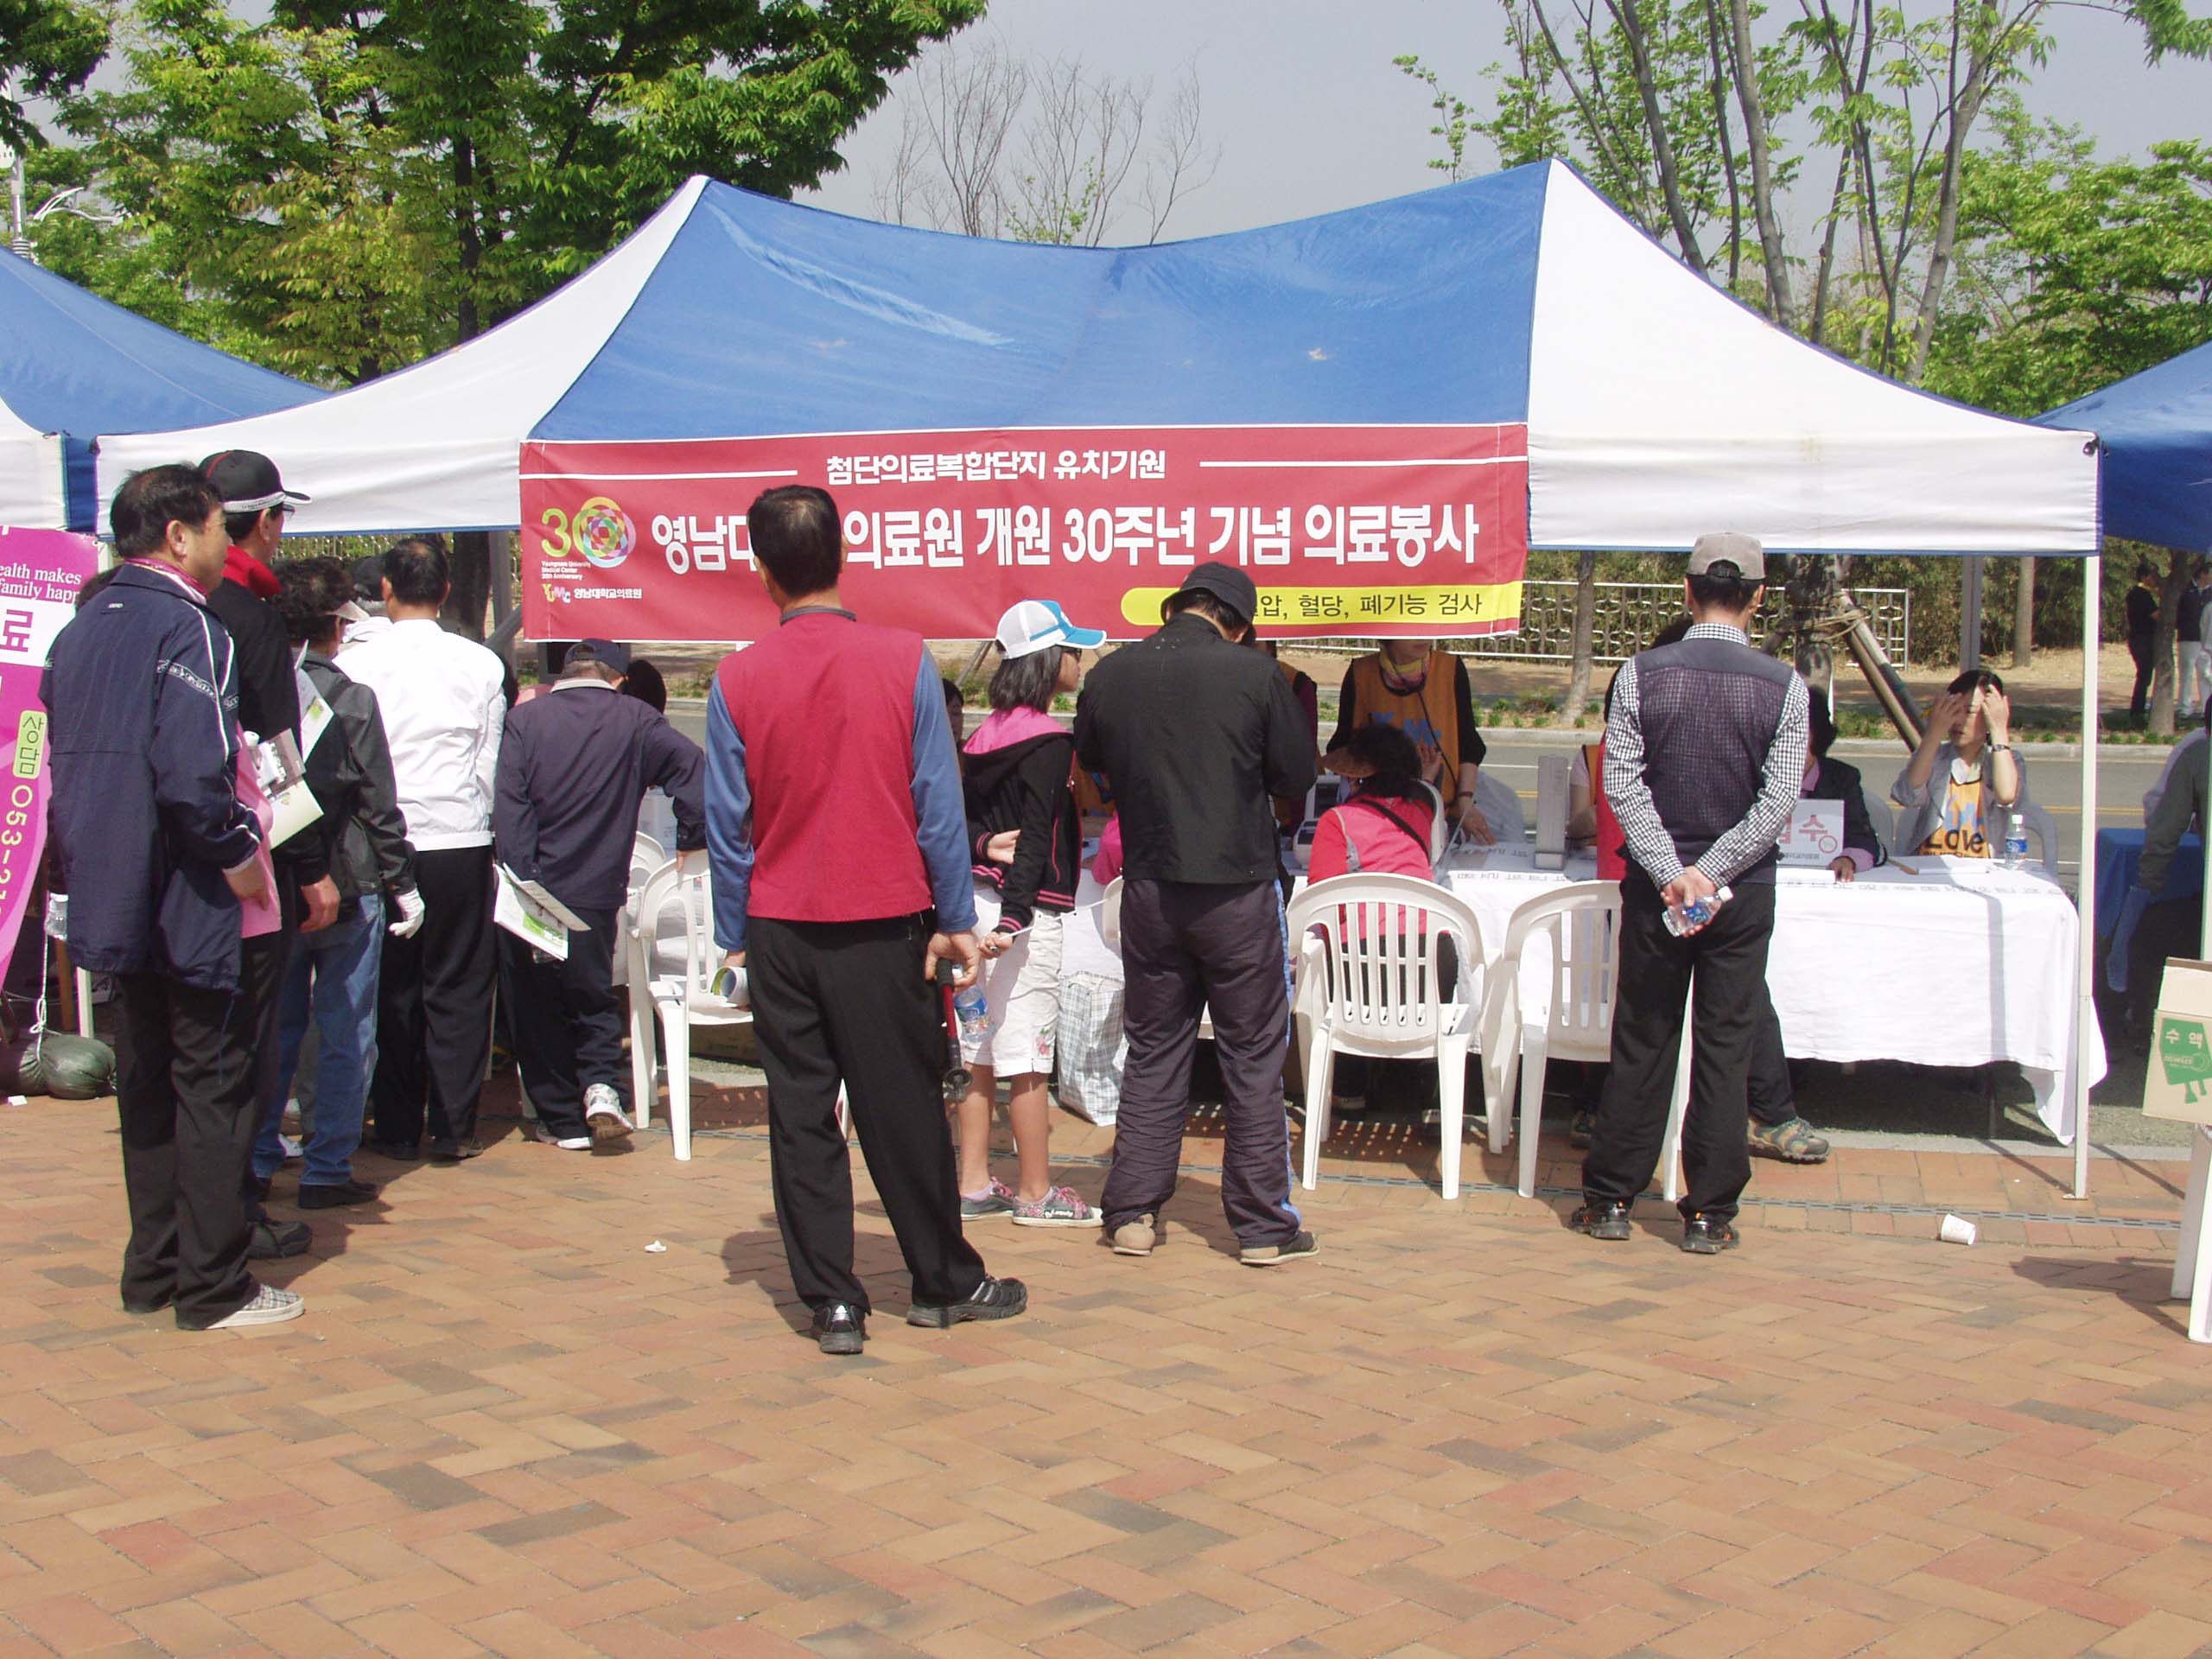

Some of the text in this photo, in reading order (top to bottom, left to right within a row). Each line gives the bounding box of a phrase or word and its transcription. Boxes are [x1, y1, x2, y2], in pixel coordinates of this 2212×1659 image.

[826, 448, 1166, 485] 첨단의료복합단지 유치기원
[976, 505, 1050, 567] 개원
[1062, 504, 1195, 567] 30주년
[1210, 505, 1291, 566] 기념
[1304, 503, 1480, 567] 의료봉사
[34, 567, 82, 585] makes
[1299, 594, 1349, 620] 혈당,
[1360, 594, 1427, 616] 폐기능
[1438, 593, 1483, 614] 검사
[20, 716, 44, 774] 상담
